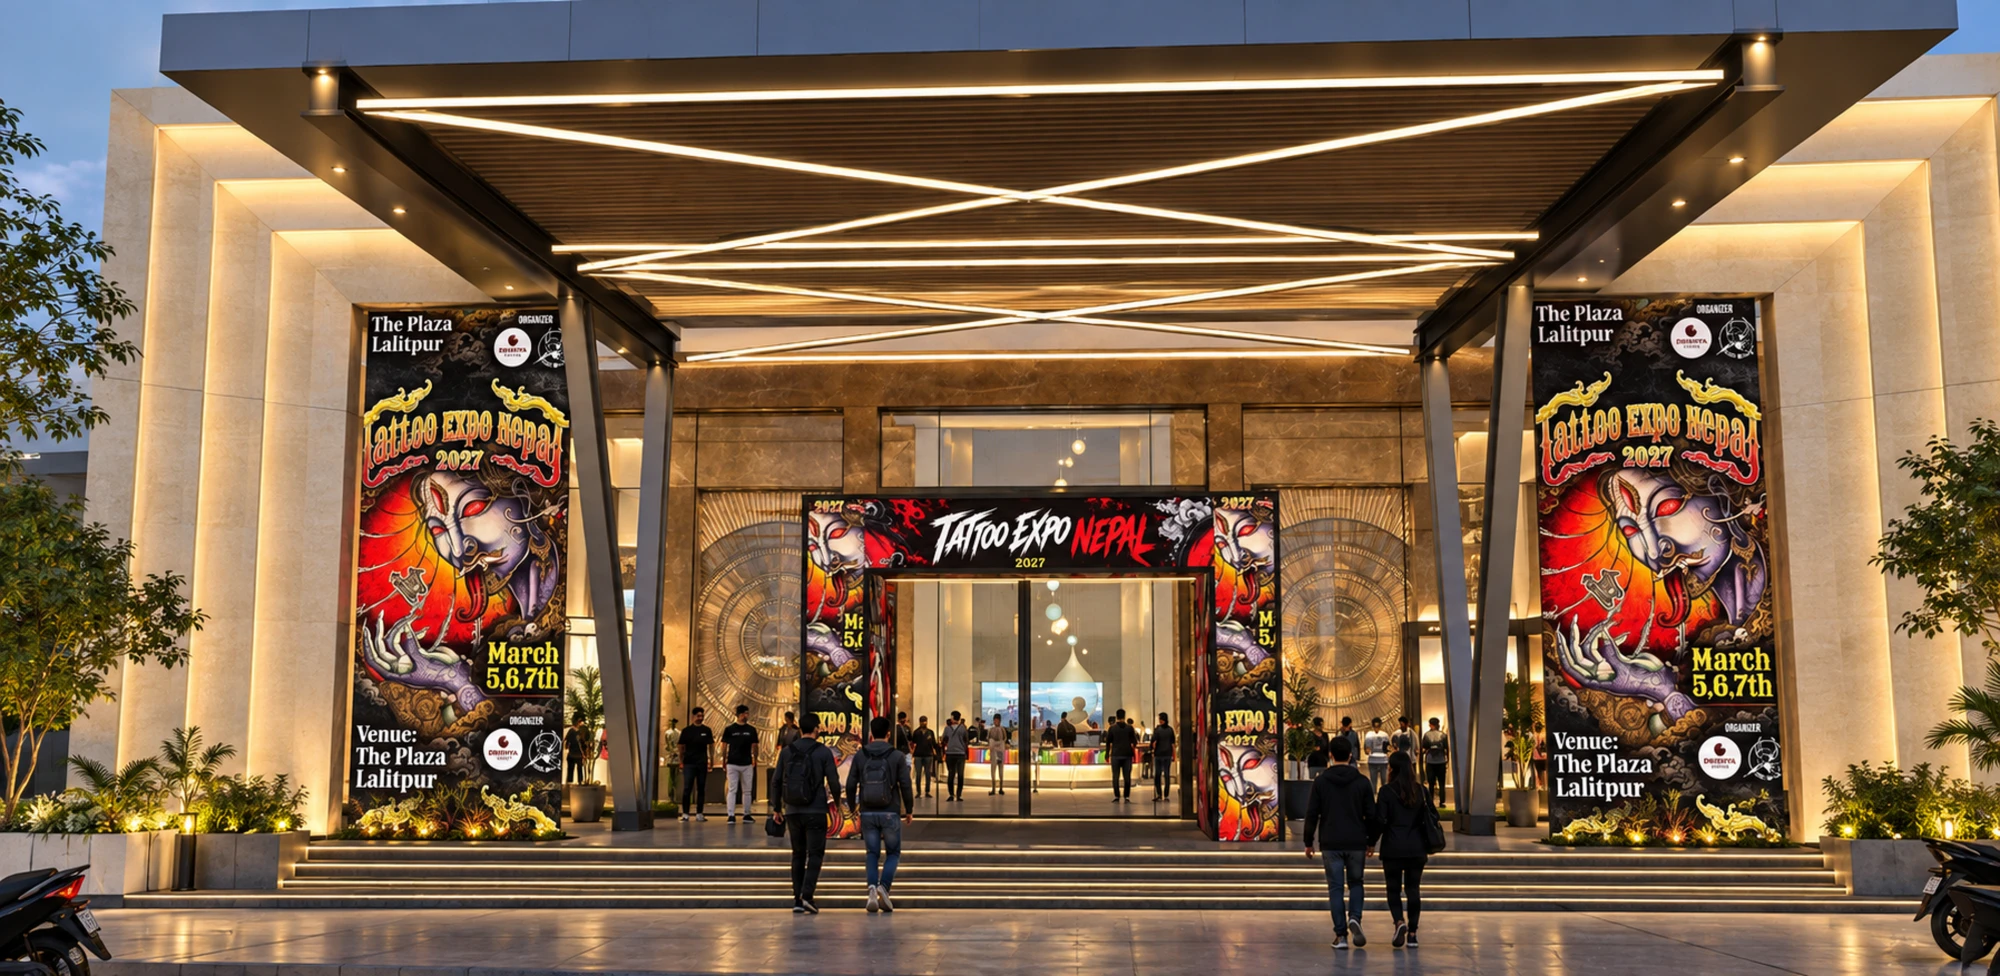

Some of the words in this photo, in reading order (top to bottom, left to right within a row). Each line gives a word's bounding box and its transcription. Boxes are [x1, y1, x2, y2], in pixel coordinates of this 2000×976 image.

[1536, 305, 1571, 322] The
[1575, 304, 1623, 321] Plaza
[372, 316, 404, 333] The
[407, 315, 452, 332] Plaza
[372, 335, 444, 355] Lalitpur
[1538, 325, 1614, 347] Lalitpur
[435, 450, 485, 471] 2027
[1622, 445, 1674, 467] 2027
[814, 500, 844, 514] 2027
[1220, 496, 1255, 511] 2027
[1008, 507, 1072, 557] EXPO
[1071, 512, 1156, 566] NEPAL
[1015, 557, 1046, 568] 2027
[487, 641, 559, 665] March
[1692, 647, 1771, 672] March
[486, 666, 559, 692] 5,6,7th
[1692, 674, 1774, 700] 5,6,7th
[356, 725, 417, 743] Venue:
[1552, 732, 1618, 750] Venue:
[356, 747, 391, 766] The
[394, 747, 446, 766] Plaza
[1554, 754, 1594, 774] The
[1596, 754, 1653, 774] Plaza
[356, 769, 438, 793] Lalitpur
[1556, 777, 1645, 802] Lalitpur
